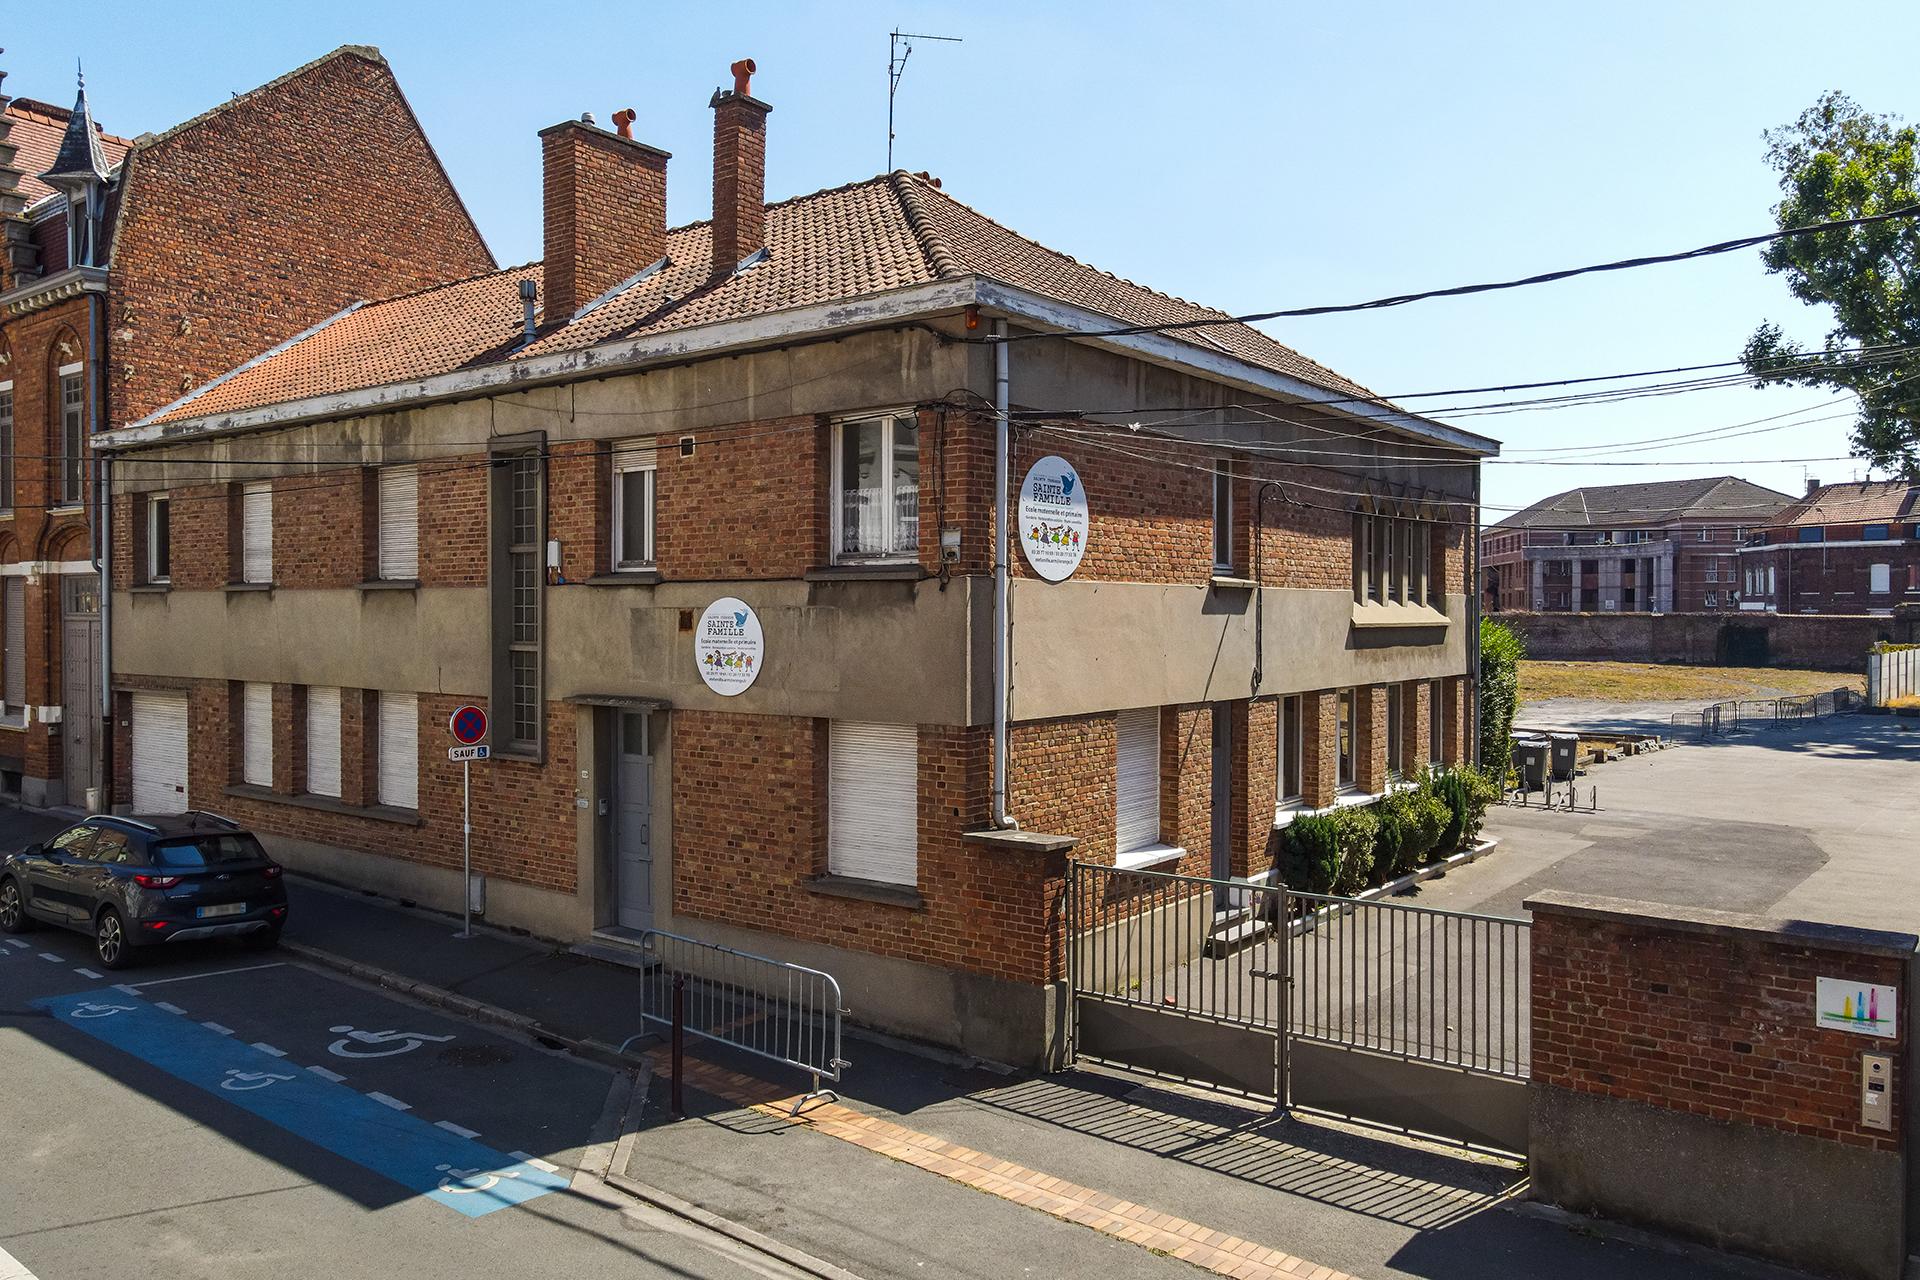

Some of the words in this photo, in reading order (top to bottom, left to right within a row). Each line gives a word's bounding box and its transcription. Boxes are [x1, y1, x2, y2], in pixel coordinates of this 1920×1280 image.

[1033, 483, 1062, 495] SAINTE
[1033, 493, 1072, 506] FAMILLE
[1066, 510, 1082, 518] primaire
[707, 620, 734, 628] SAINTE
[707, 628, 744, 636] FAMILLE
[454, 749, 475, 758] SAUF
